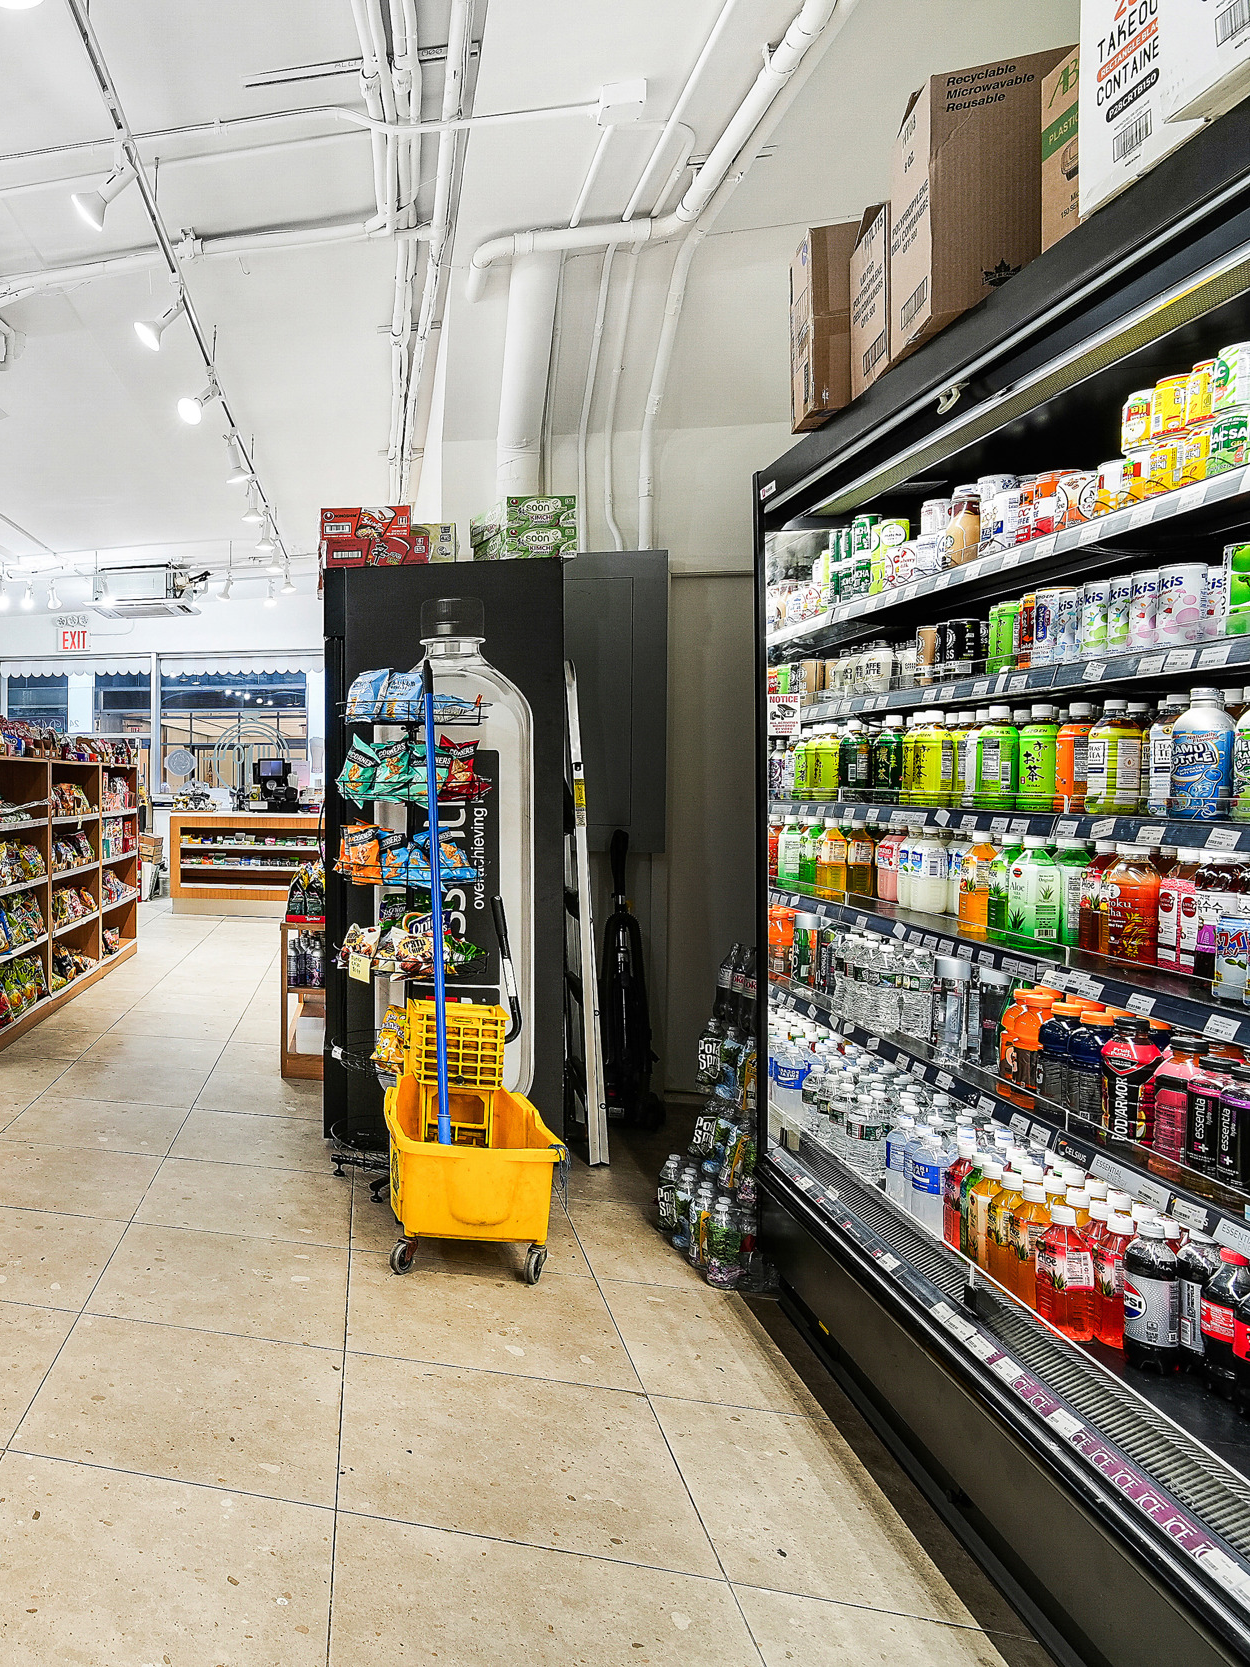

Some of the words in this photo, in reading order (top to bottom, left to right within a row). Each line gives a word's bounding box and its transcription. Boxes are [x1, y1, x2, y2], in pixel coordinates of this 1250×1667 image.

[1100, 38, 1141, 77] RECTANGLE
[946, 63, 1017, 87] Recyclable
[1096, 35, 1159, 107] CONTAINE
[946, 72, 1036, 101] Microwavable
[1108, 72, 1156, 118] P28CRTB150
[946, 91, 1006, 113] Reusable
[892, 178, 929, 240] POLYPROPYLENE
[901, 195, 929, 247] CONTAINERS
[853, 263, 884, 310] POLYPROPYLENE
[526, 504, 550, 512] soon
[1132, 580, 1156, 597] lkis
[1158, 575, 1183, 592] lkis
[63, 631, 86, 649] EXIT
[1187, 732, 1217, 741] Naturally
[350, 753, 375, 766] CORNER
[1171, 751, 1215, 766] OTTLE
[1172, 742, 1207, 755] AMU
[471, 807, 487, 910] overachieving
[1010, 882, 1025, 892] Aloe
[412, 919, 433, 934] Oni
[1195, 1097, 1206, 1141] essentia
[1221, 1107, 1231, 1152] essentia
[1065, 1144, 1087, 1163] CELSIUS
[1095, 1157, 1122, 1179] ESSENTIAL
[1124, 1293, 1143, 1310] PSI
[1028, 1390, 1053, 1413] ICE
[1070, 1430, 1093, 1450] CE
[1090, 1446, 1117, 1472] ICE
[1112, 1467, 1142, 1494] ICE
[1135, 1491, 1168, 1518] ICE
[1161, 1514, 1197, 1544] ICE
